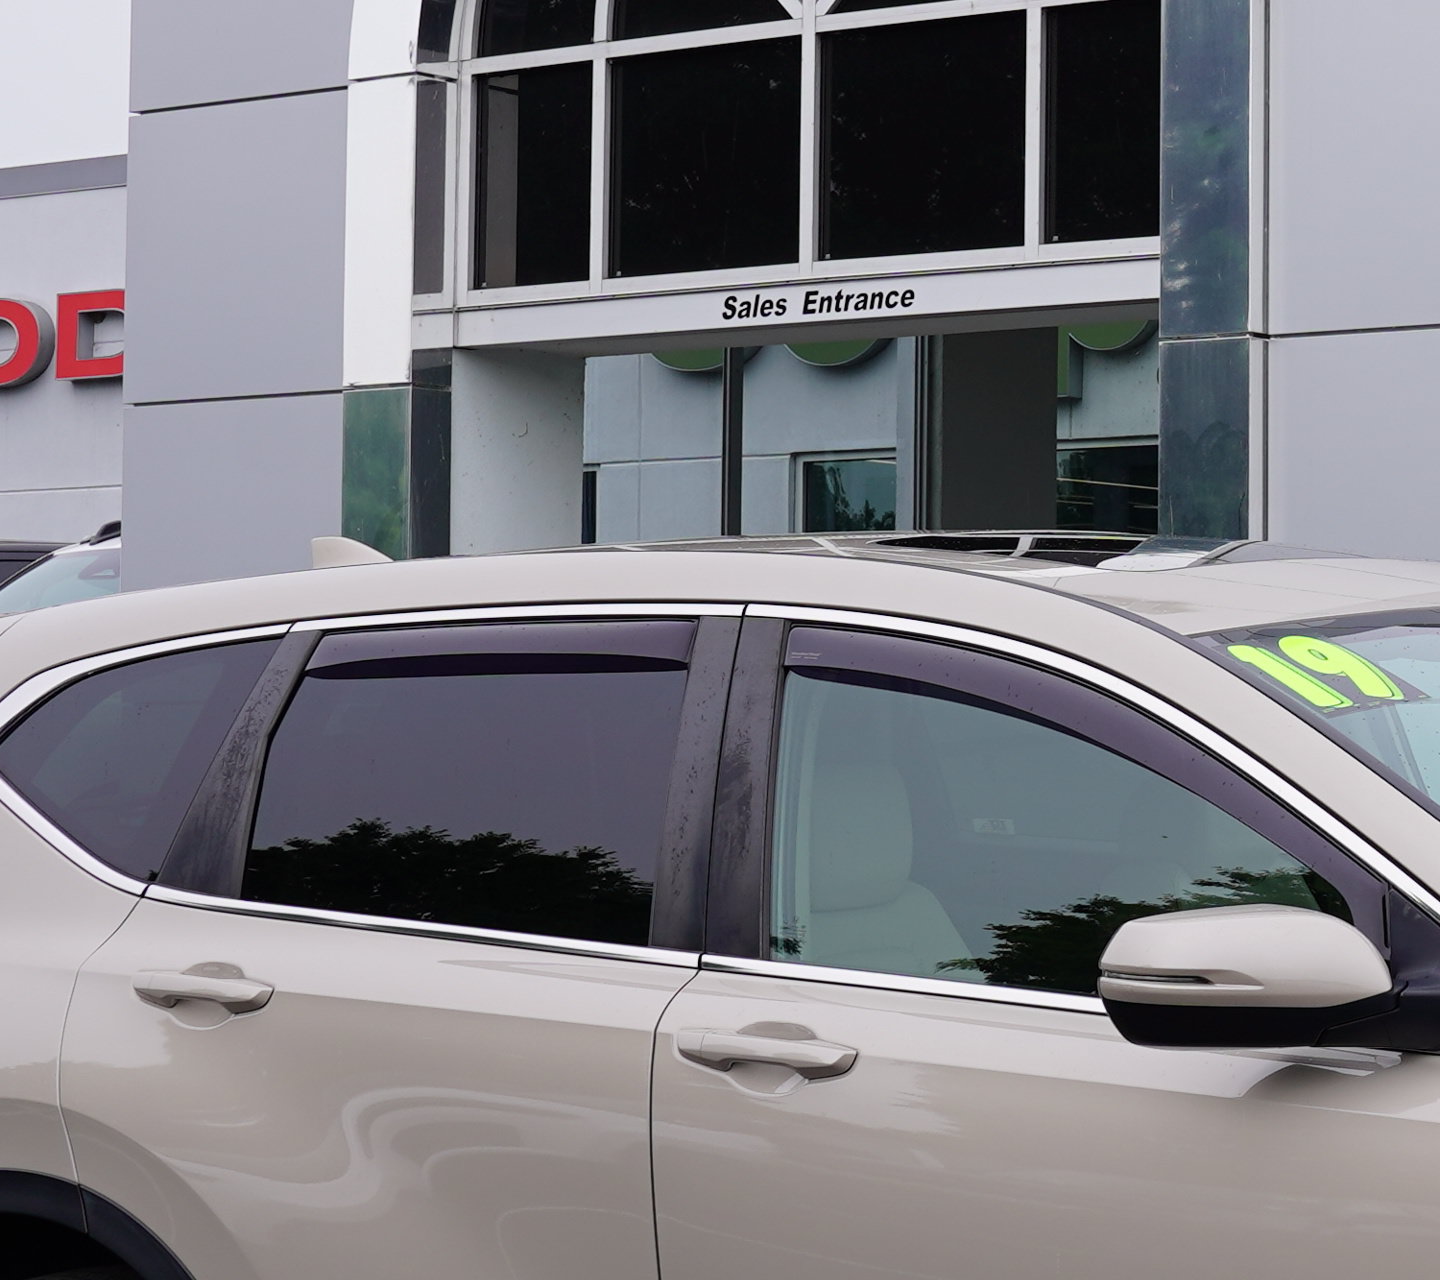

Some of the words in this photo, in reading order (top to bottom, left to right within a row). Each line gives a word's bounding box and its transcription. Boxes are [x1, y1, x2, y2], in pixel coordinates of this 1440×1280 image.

[722, 294, 787, 320] Sales
[802, 289, 915, 315] Entrance
[1226, 635, 1405, 708] 19
